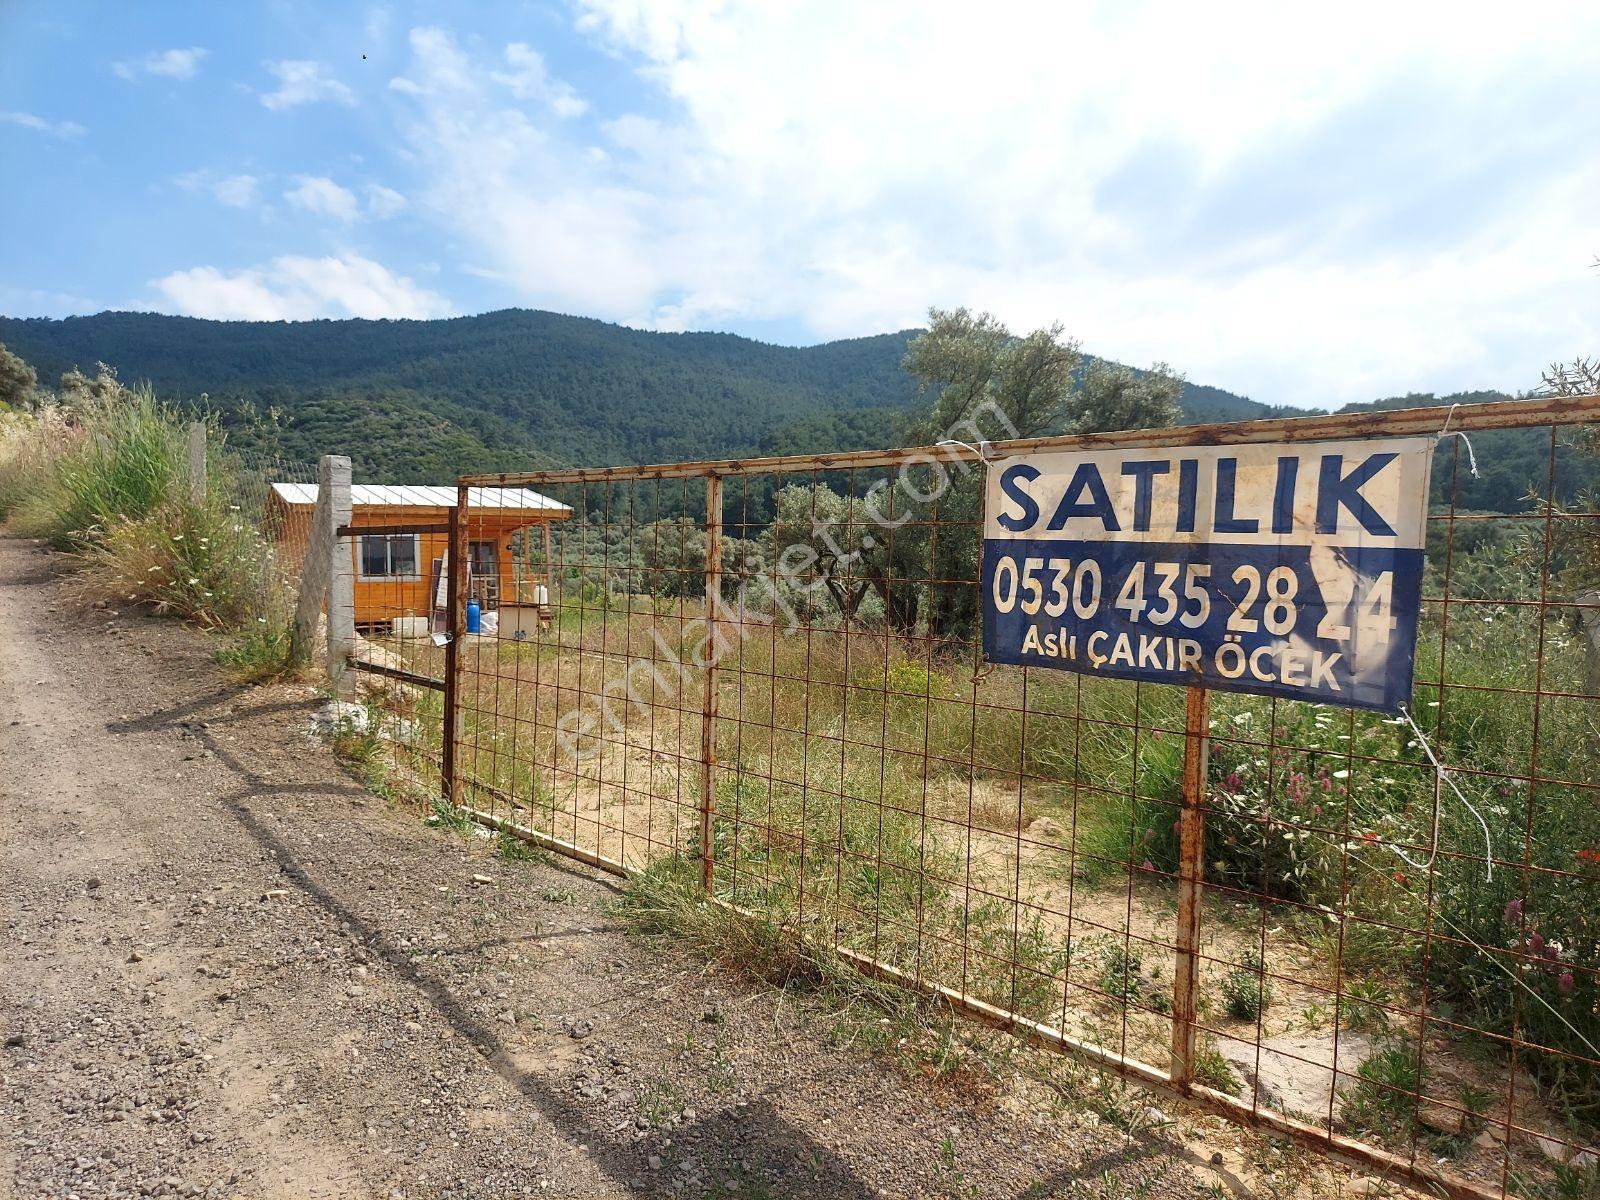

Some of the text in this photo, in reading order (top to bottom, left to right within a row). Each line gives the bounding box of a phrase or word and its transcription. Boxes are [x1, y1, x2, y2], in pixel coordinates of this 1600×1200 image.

[996, 452, 1399, 537] SATILIK
[992, 556, 1102, 620] 0530
[1115, 561, 1211, 629] 435
[1227, 565, 1299, 636] 28
[1021, 625, 1342, 692] Aslı ÇAKIR ÖCEK
